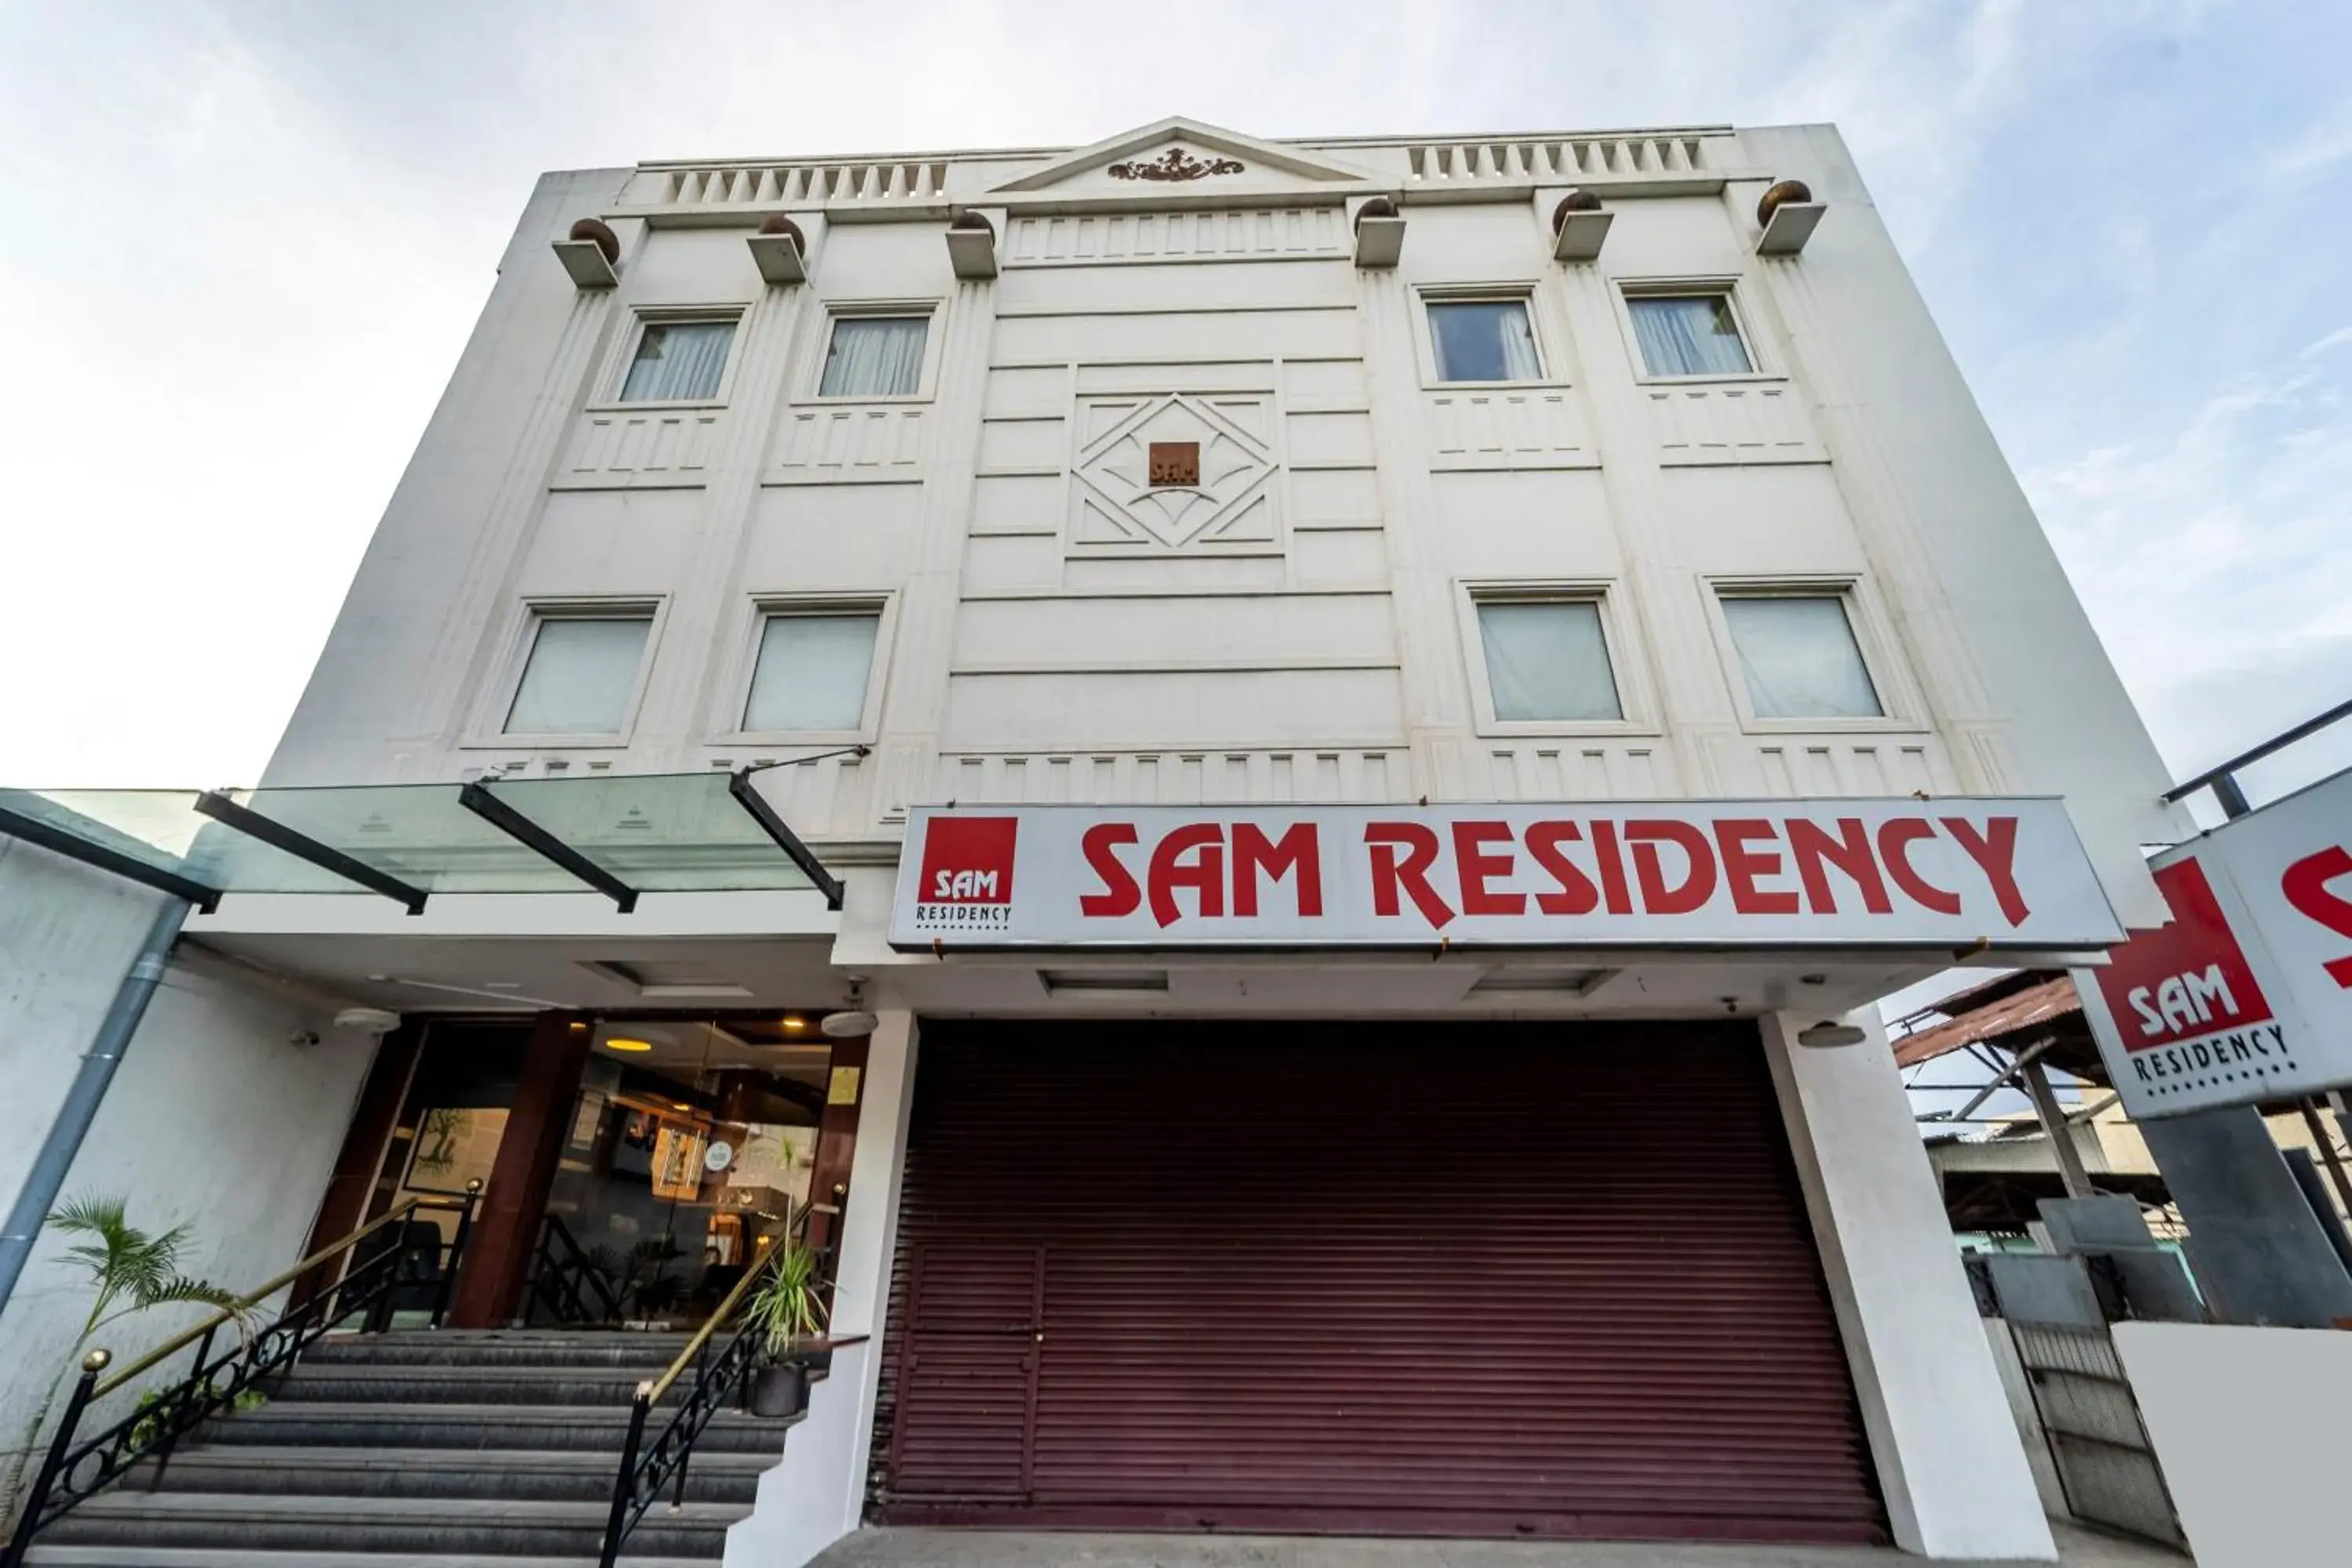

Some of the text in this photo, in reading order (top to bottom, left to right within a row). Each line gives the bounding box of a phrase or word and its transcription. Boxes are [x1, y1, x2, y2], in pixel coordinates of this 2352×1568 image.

[934, 869, 999, 900] SAM
[1080, 816, 2031, 931] SAM RESIDENCY
[916, 906, 1012, 922] RESIDENCY
[2128, 963, 2240, 1037] SAM
[2132, 1024, 2288, 1082] RESIDENCY
